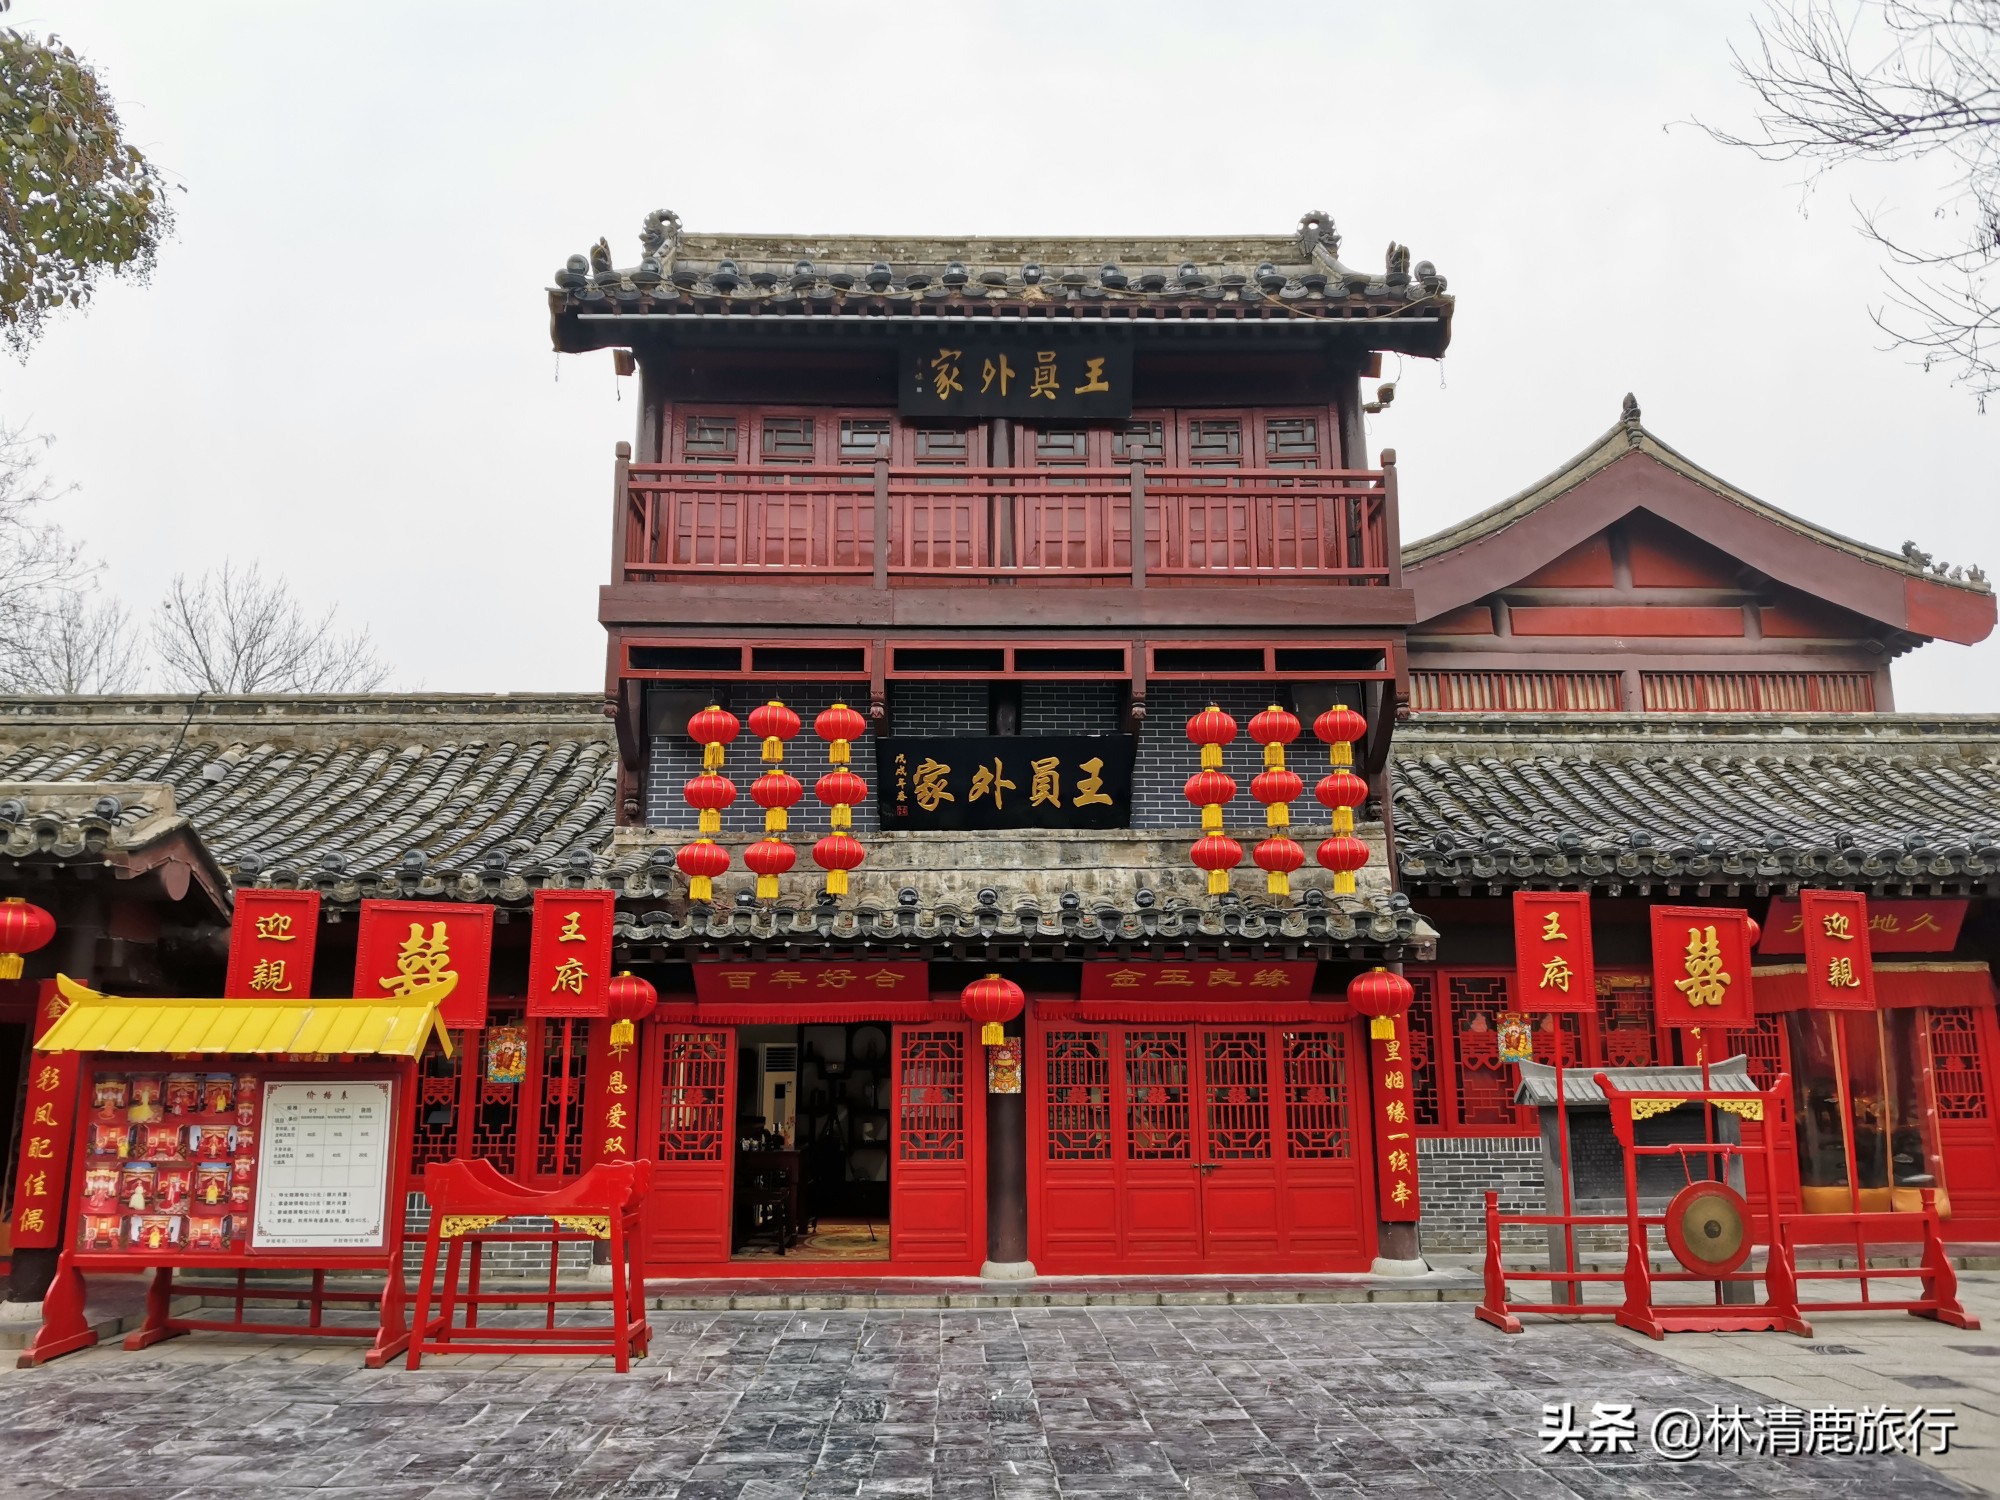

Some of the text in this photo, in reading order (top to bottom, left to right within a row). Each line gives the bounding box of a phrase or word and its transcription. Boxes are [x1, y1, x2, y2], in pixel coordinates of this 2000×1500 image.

[248, 912, 296, 993] 迎親
[551, 911, 589, 995] 王府
[1539, 911, 1574, 993] 王府
[1784, 912, 1942, 933] 天地久
[1822, 911, 1861, 988] 迎親
[718, 968, 906, 990] 百年好合
[1105, 968, 1291, 988] 金玉良缘
[19, 994, 71, 1233] 金彩凤配佳偶
[306, 1090, 349, 1100] 价格表
[1384, 1014, 1413, 1209] 里姻缘一线牵
